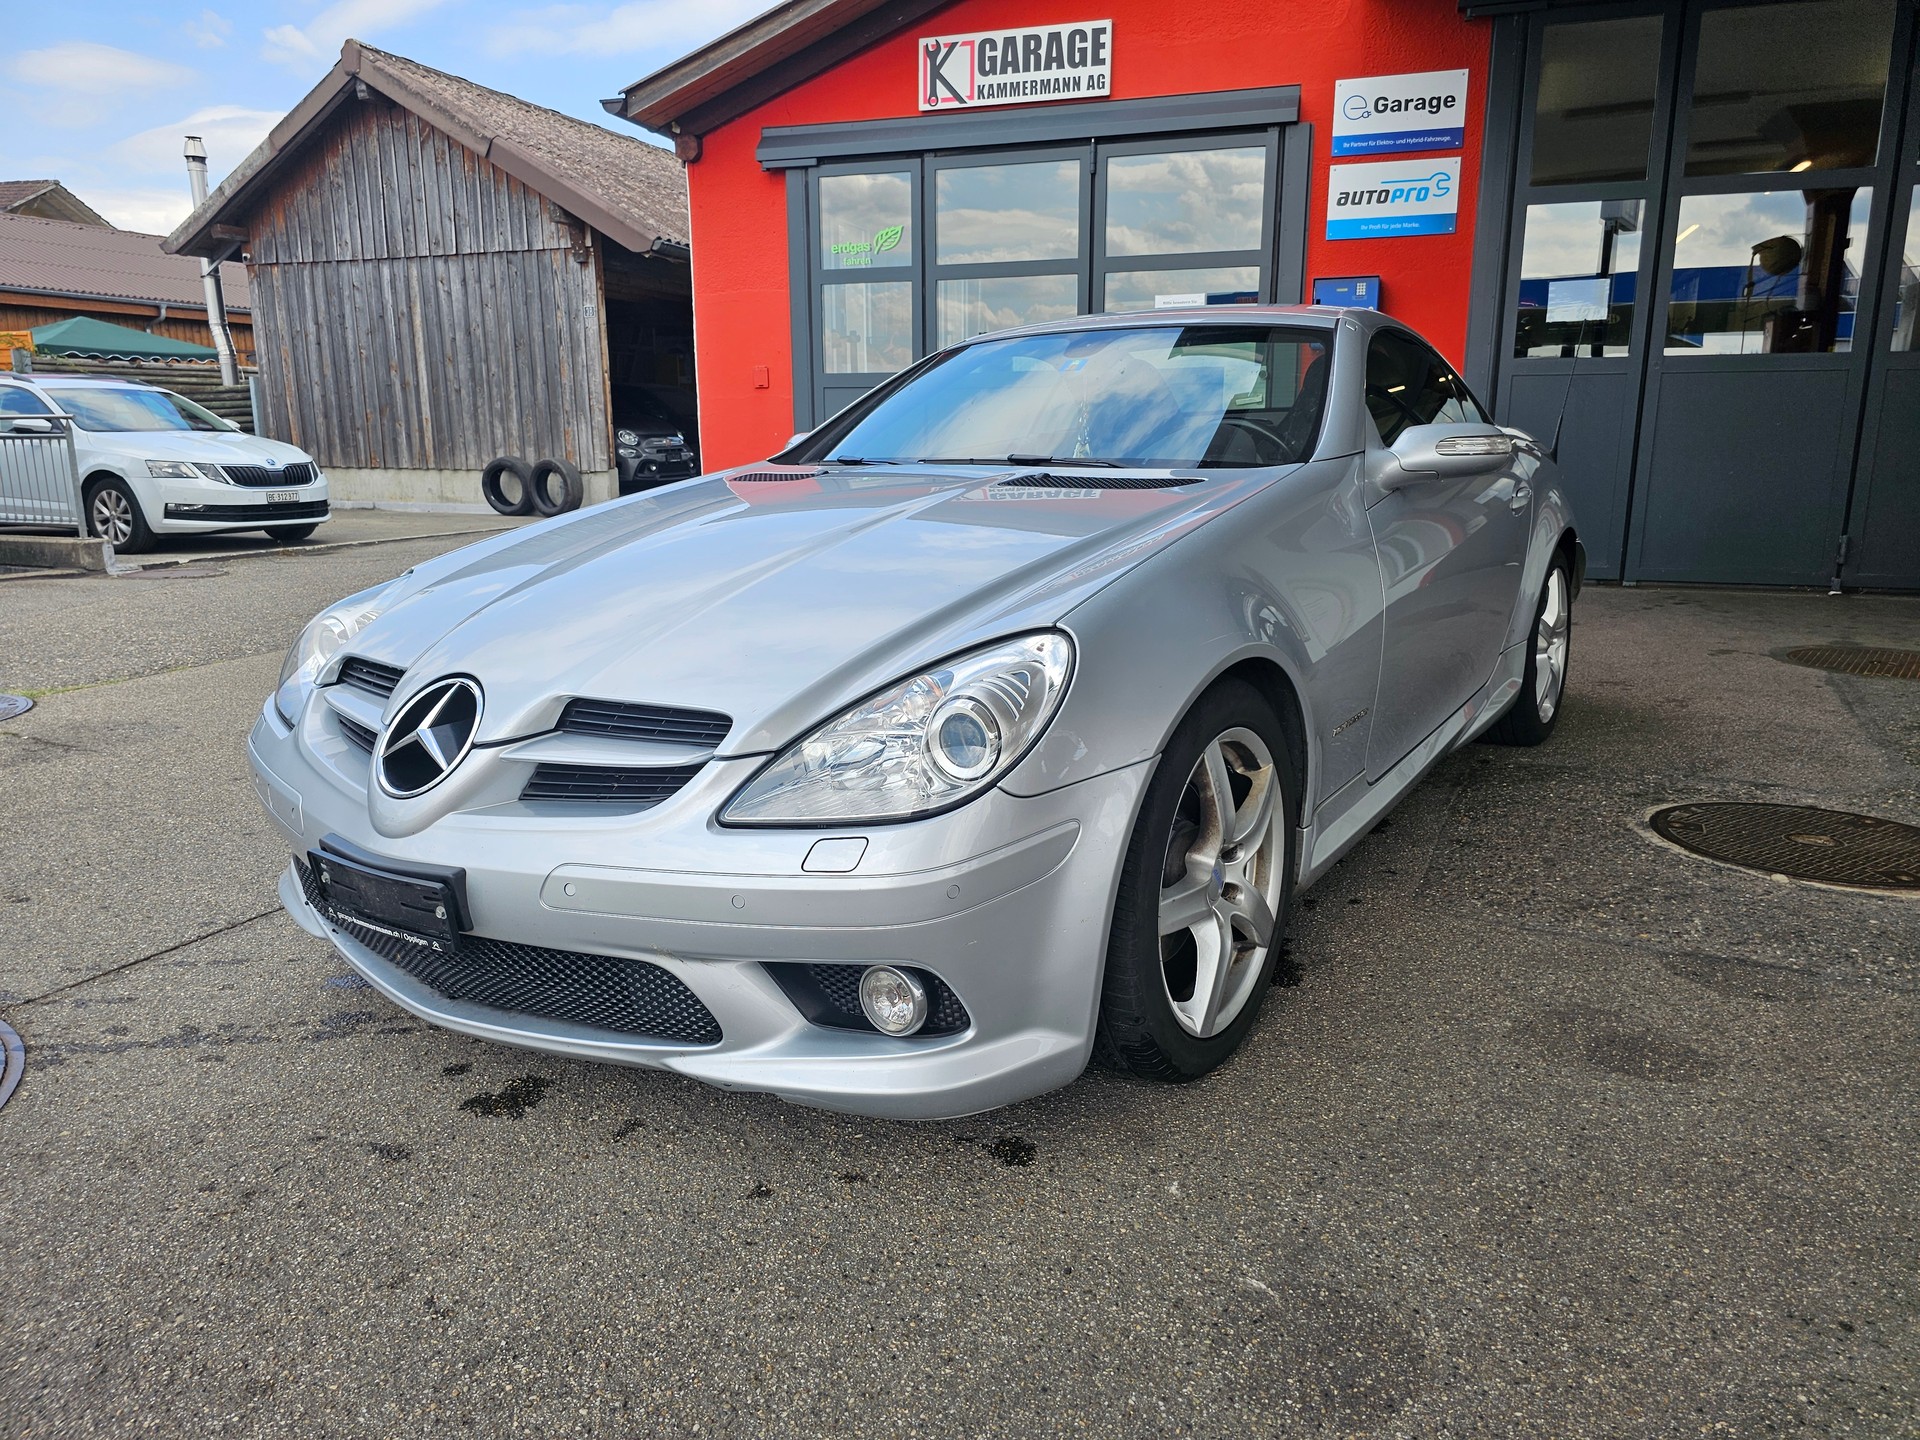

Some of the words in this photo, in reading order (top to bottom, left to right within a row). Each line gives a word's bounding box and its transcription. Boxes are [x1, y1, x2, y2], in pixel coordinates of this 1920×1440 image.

[977, 27, 1107, 77] GARAGE
[977, 77, 1081, 100] KAMMERMANN
[1086, 73, 1106, 91] AG
[1374, 95, 1456, 114] Garage
[831, 241, 872, 255] erdgas
[843, 257, 873, 266] fahren
